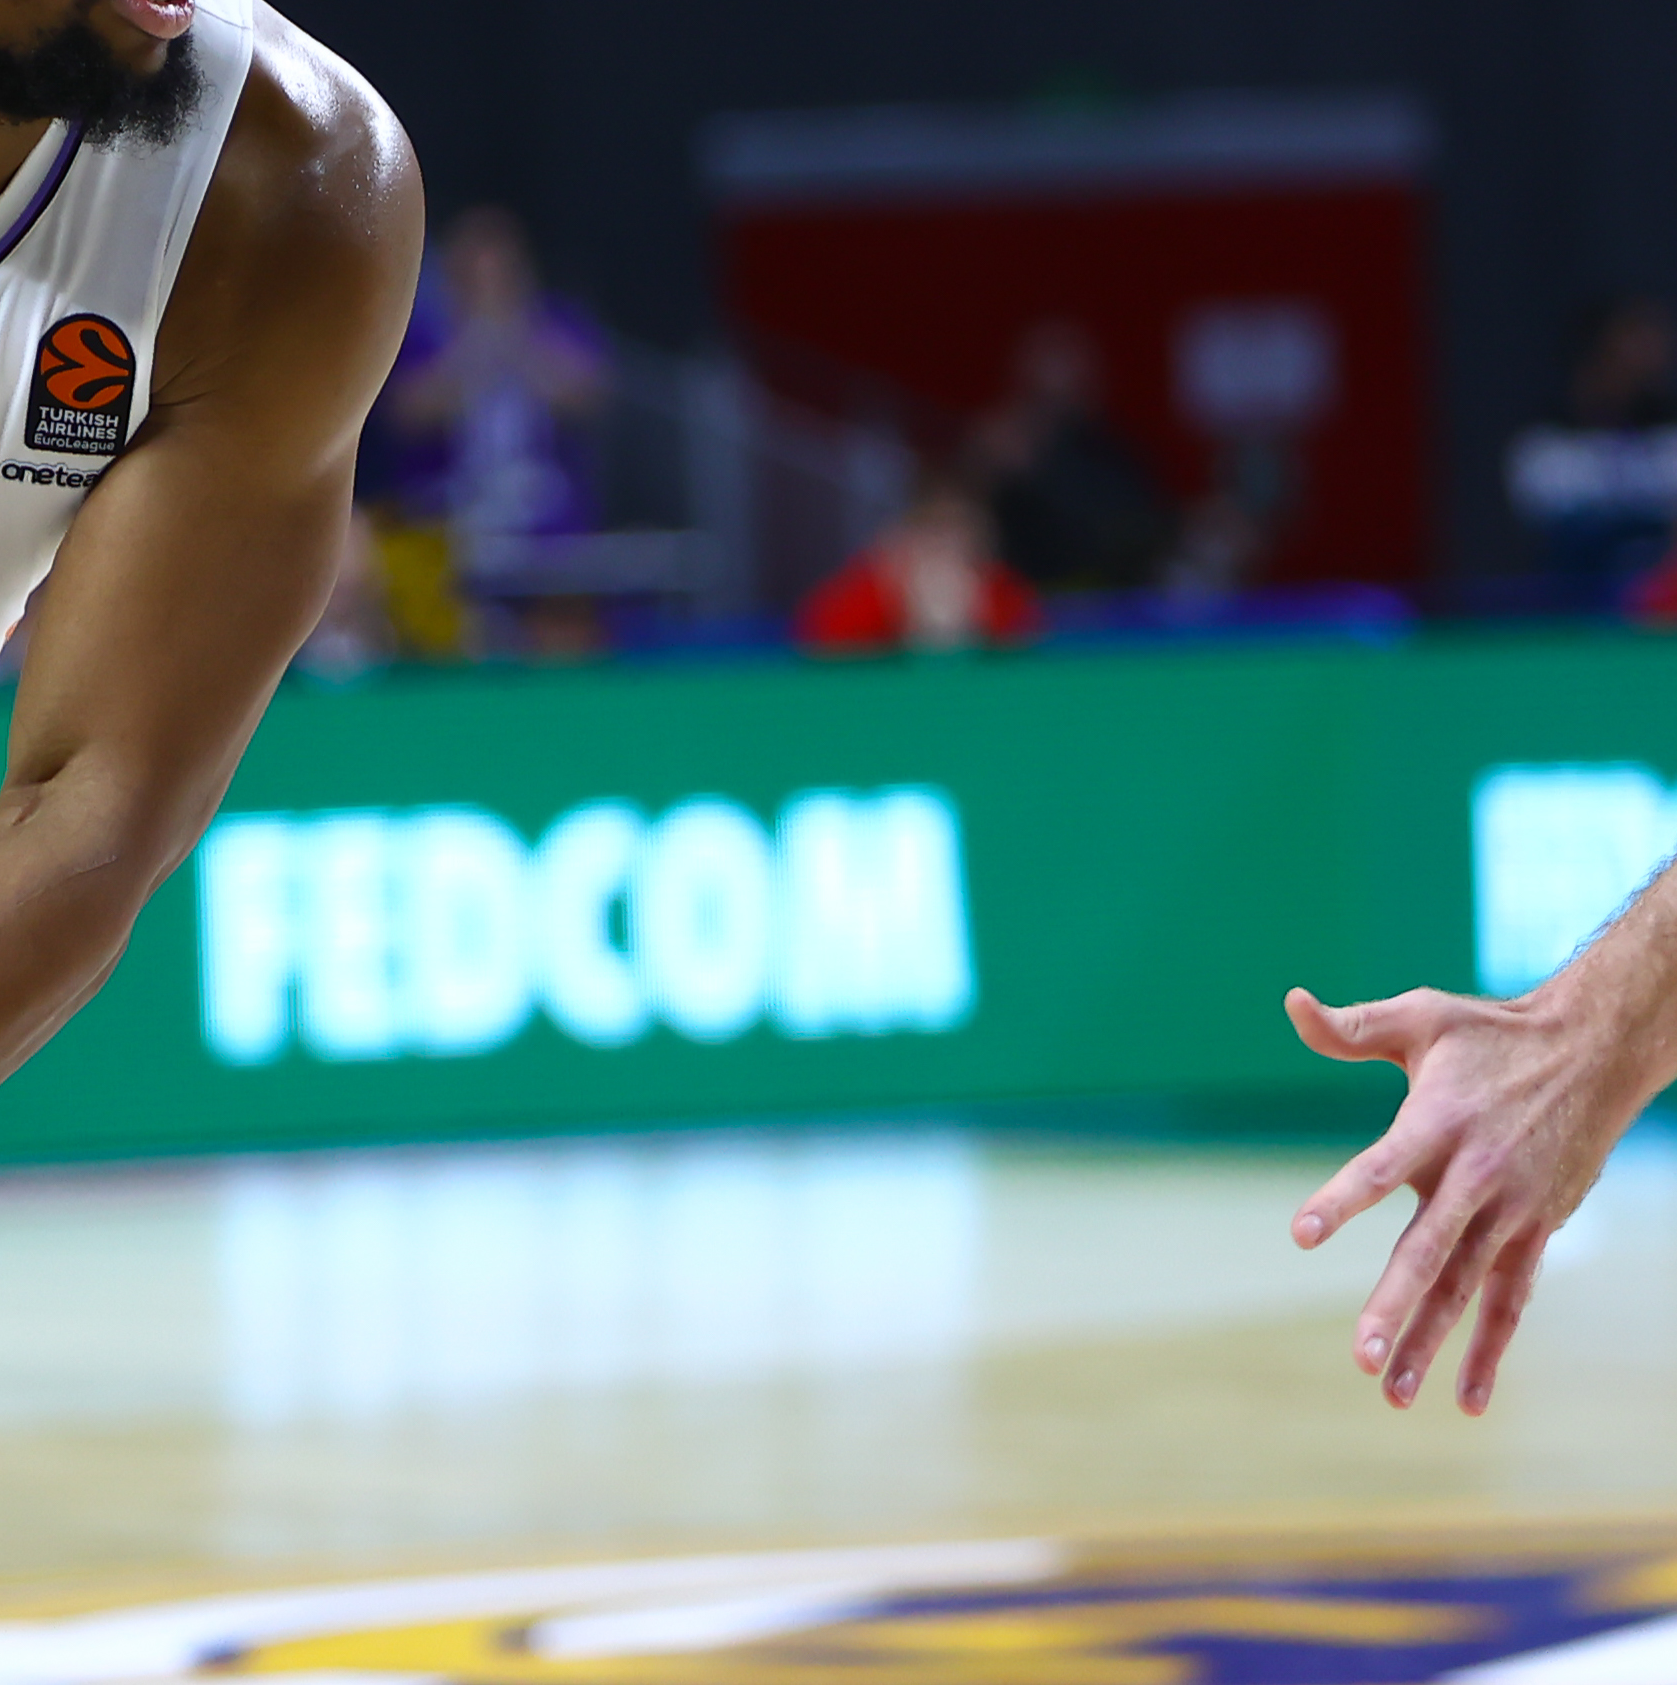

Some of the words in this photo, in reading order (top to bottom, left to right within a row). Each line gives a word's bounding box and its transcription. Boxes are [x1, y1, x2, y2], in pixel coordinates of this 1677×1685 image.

[39, 406, 119, 428] TURKISH
[36, 420, 117, 440] AIRLINES
[34, 433, 115, 453] EuroLeague
[1, 463, 100, 488] onetea
[200, 785, 976, 1067] FEDCOM
